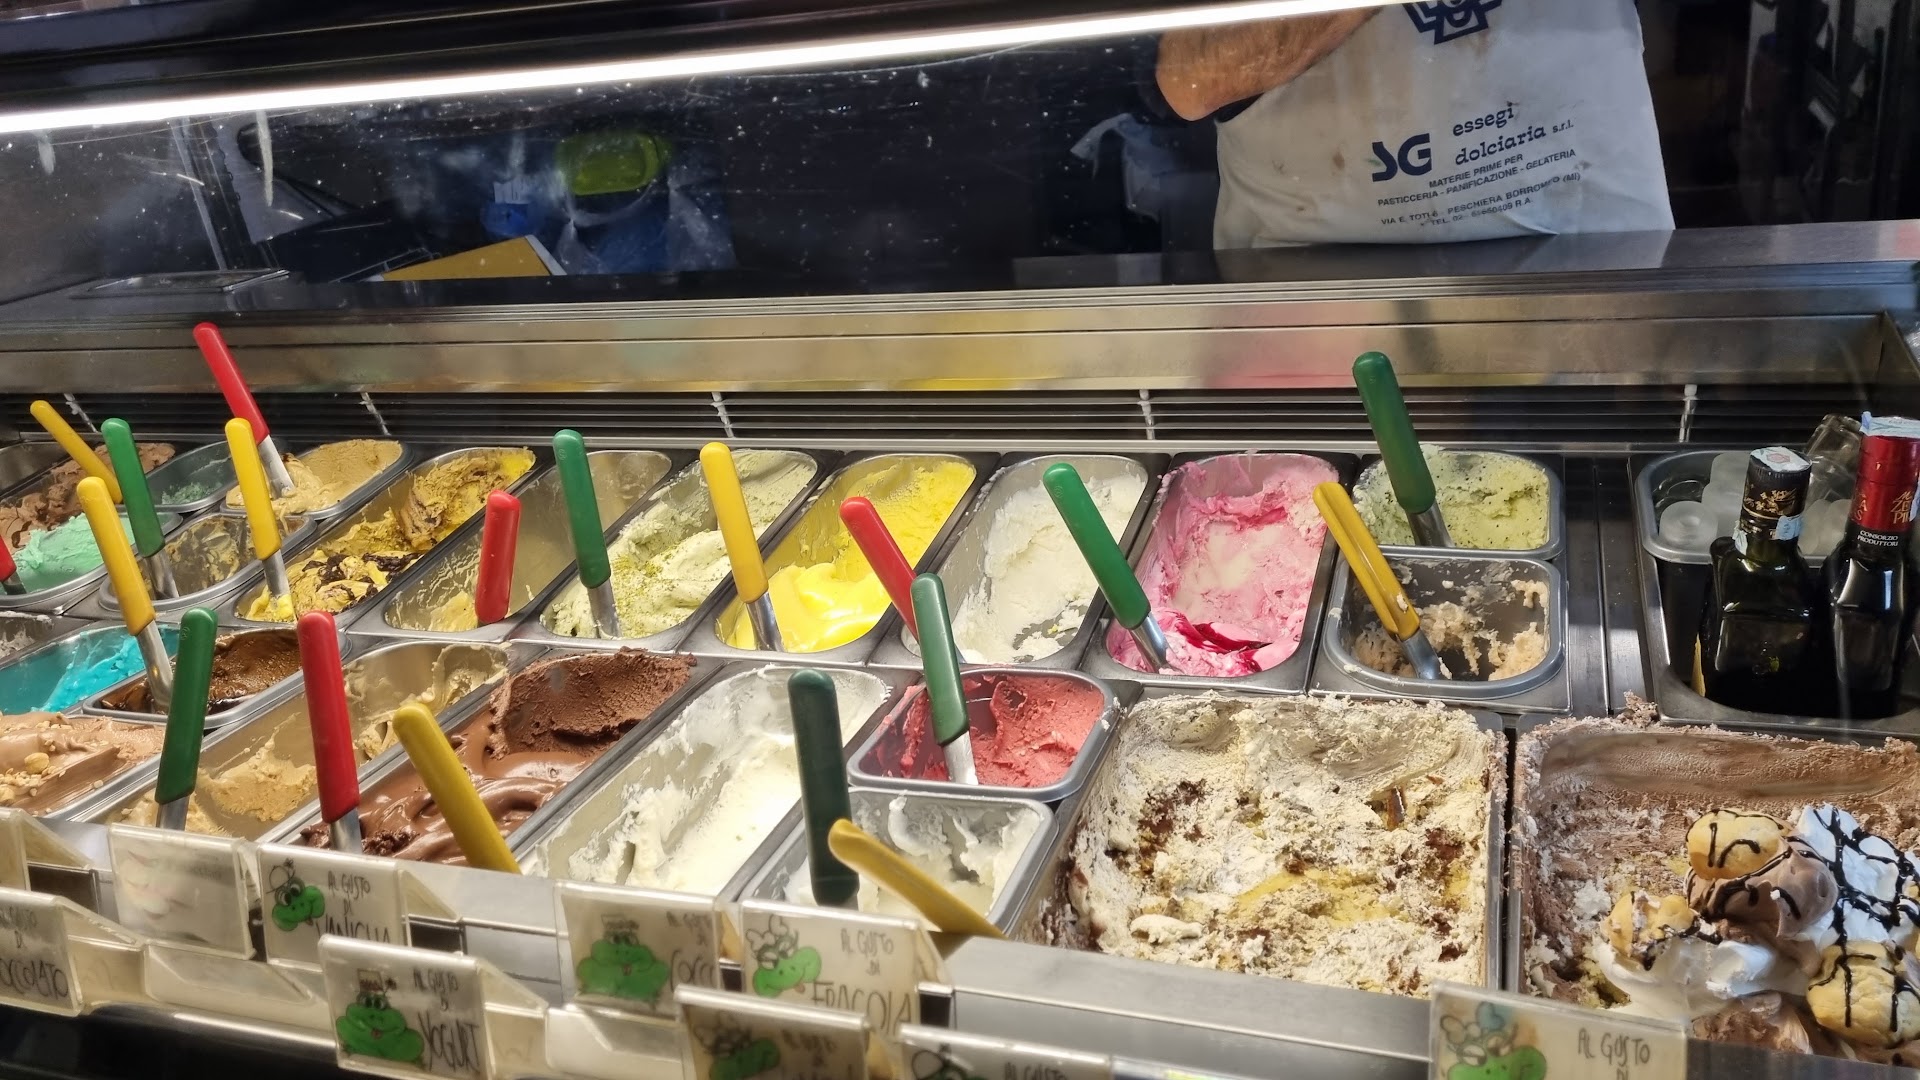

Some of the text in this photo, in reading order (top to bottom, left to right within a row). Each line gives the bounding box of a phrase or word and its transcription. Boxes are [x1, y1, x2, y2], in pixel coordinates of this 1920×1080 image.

[1453, 101, 1514, 136] essegi
[1455, 126, 1547, 165] dolciaria
[1378, 191, 1439, 207] PASTICCERIA
[1446, 166, 1519, 194] PANIFICAZIONE
[1526, 148, 1577, 170] GELATERIA
[1429, 153, 1524, 188] MATERIE PRIME PER
[1381, 215, 1396, 225] VIA
[1447, 194, 1503, 215] PESCHIERA
[1857, 534, 1899, 547] PRODUTTORI
[1860, 530, 1899, 541] CONSORZIO
[417, 1009, 480, 1074] YOGURT
[1601, 1032, 1650, 1067] GUSTO
